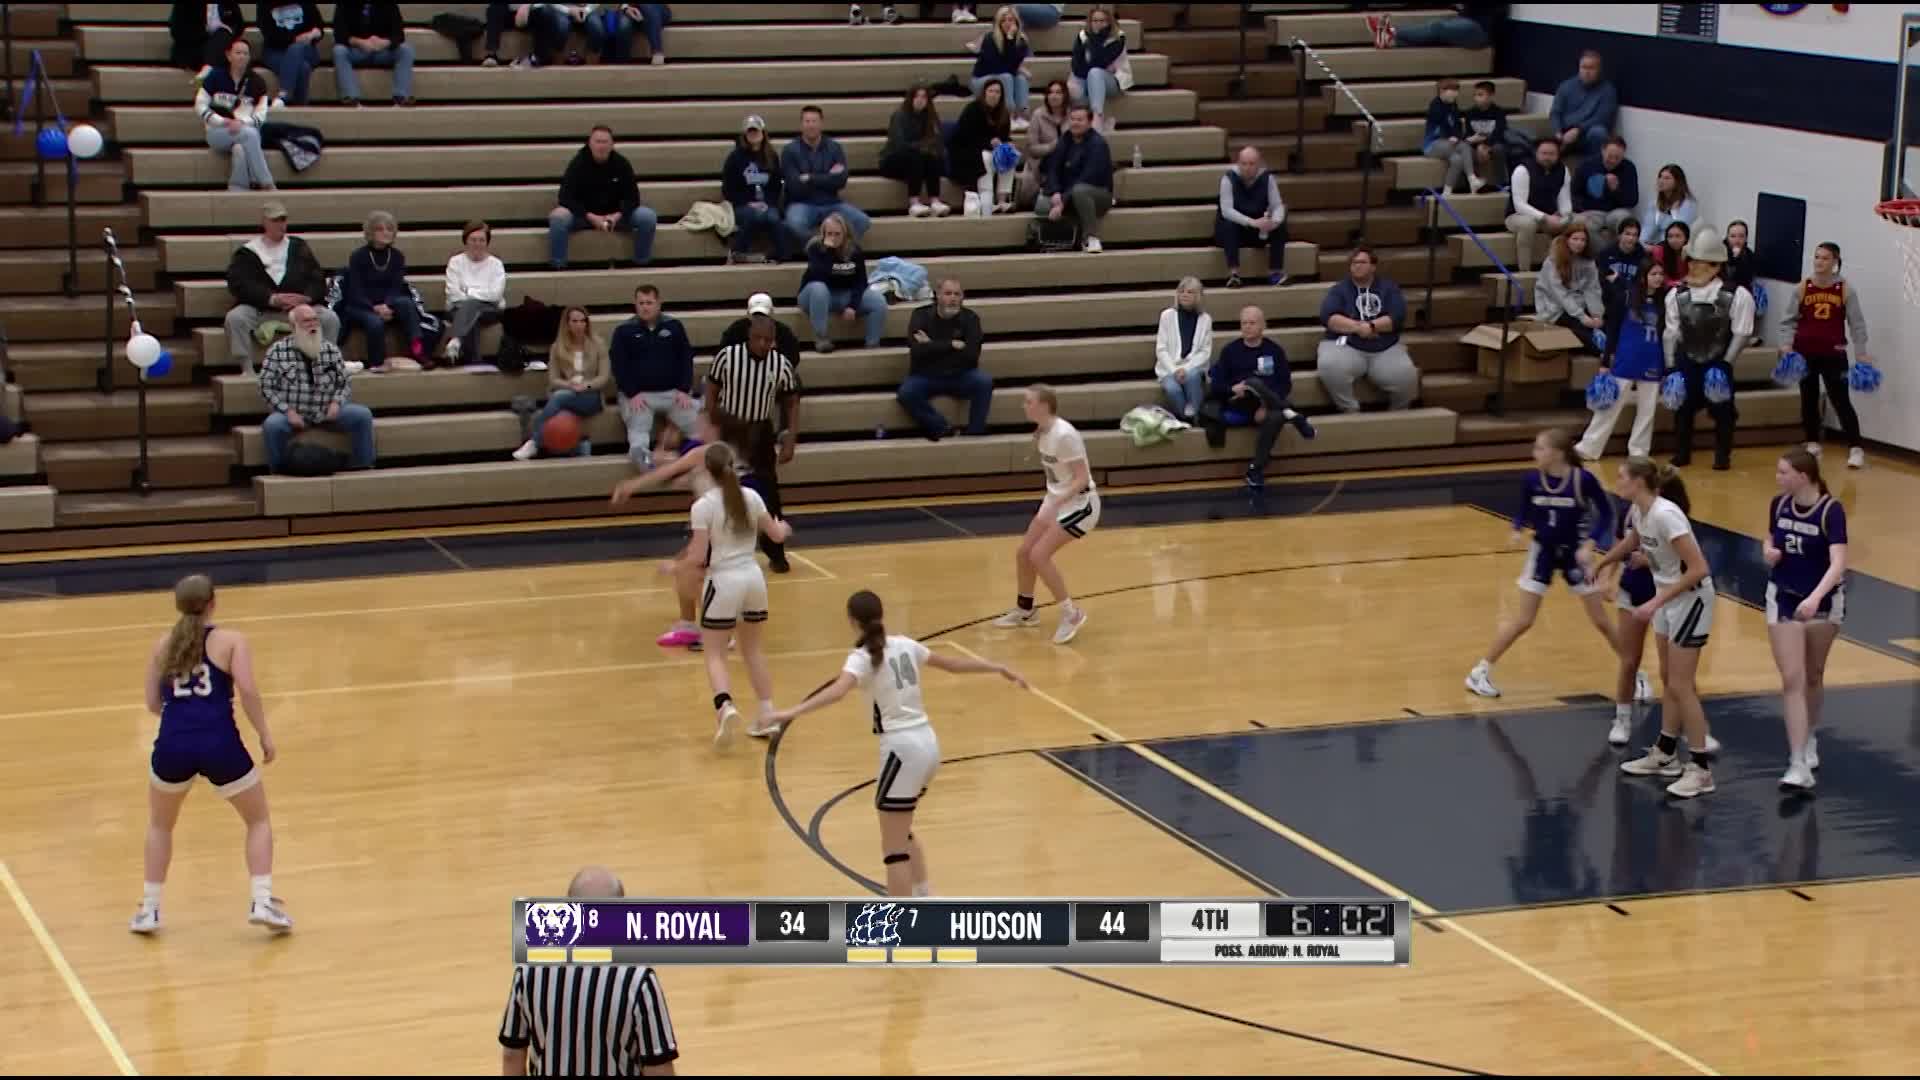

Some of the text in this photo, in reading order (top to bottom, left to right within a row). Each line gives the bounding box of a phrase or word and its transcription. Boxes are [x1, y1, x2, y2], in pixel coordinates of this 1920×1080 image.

[1814, 303, 1831, 319] 23
[1784, 533, 1804, 554] 21
[172, 663, 213, 698] 23
[889, 652, 918, 690] 14
